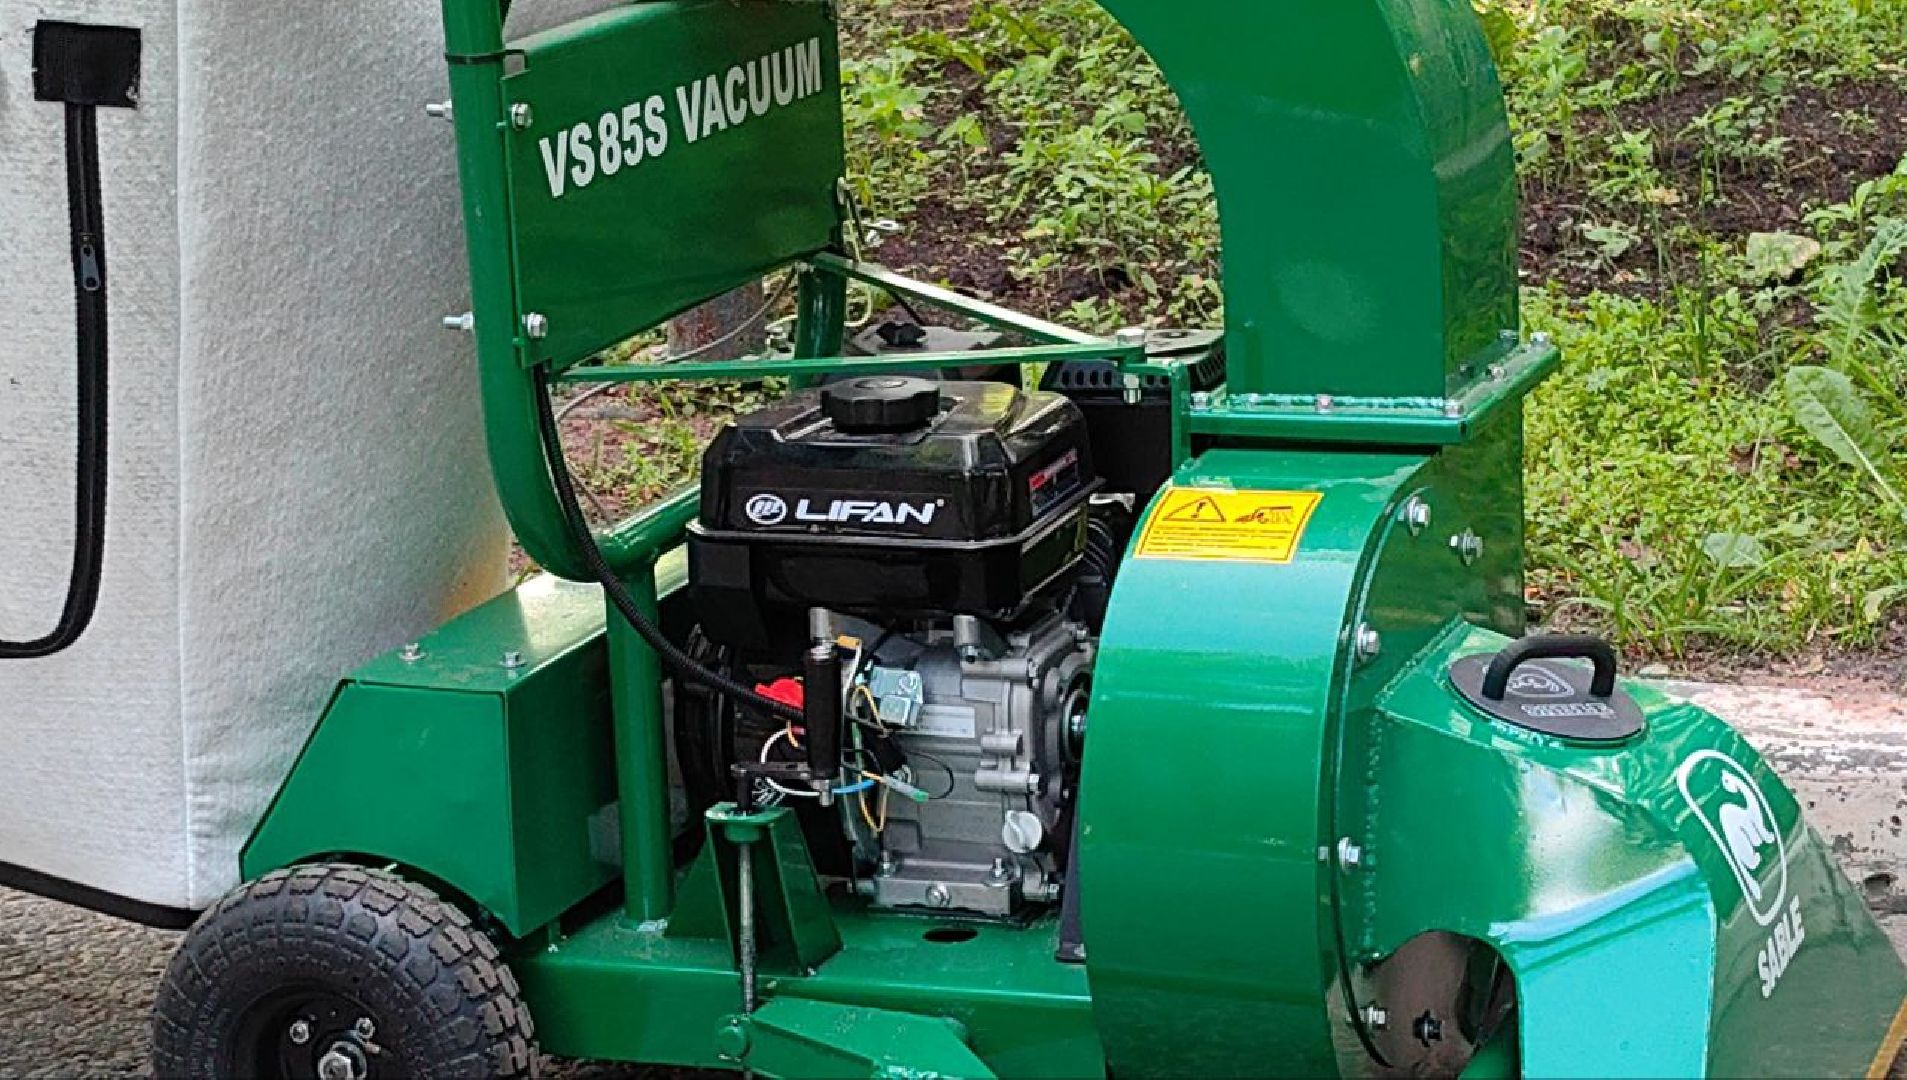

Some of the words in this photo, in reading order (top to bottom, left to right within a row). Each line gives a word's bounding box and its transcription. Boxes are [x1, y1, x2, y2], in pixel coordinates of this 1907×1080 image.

[676, 37, 823, 144] VACUUM
[795, 498, 936, 525] LIFAN
[1758, 894, 1805, 999] SABLE
